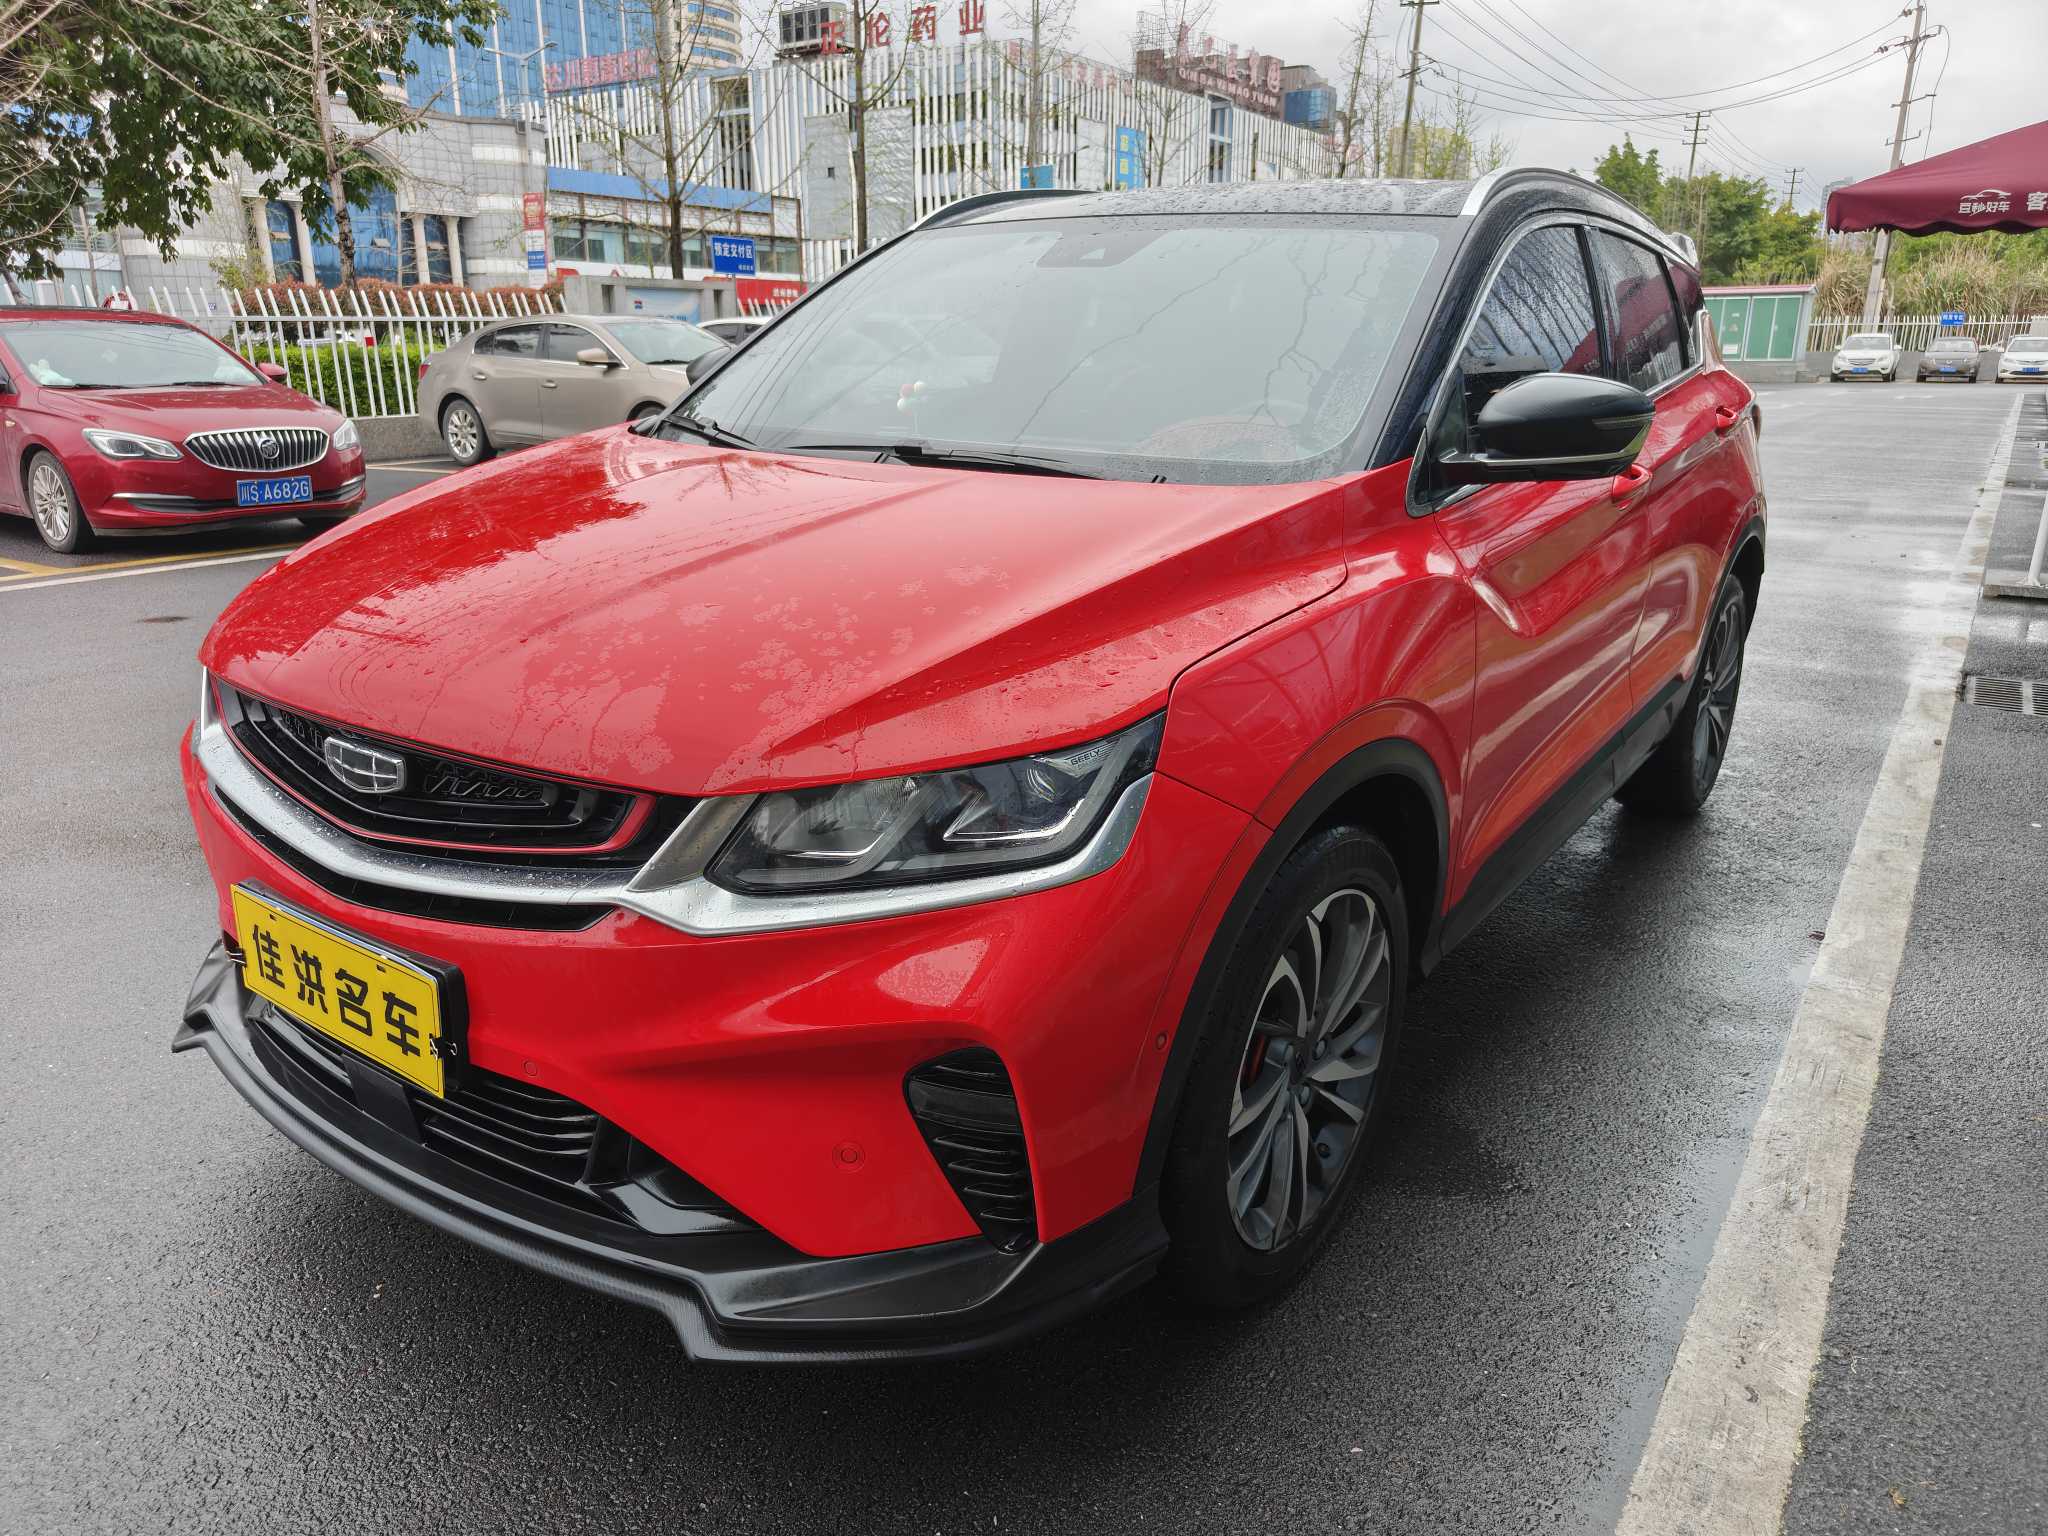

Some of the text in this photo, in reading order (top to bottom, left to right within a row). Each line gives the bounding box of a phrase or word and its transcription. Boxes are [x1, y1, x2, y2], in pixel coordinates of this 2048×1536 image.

[819, 0, 984, 55] 正伦药业
[714, 242, 753, 259] 预定交付区
[1071, 748, 1100, 766] GEELY
[252, 923, 421, 1057] 佳洪名车
